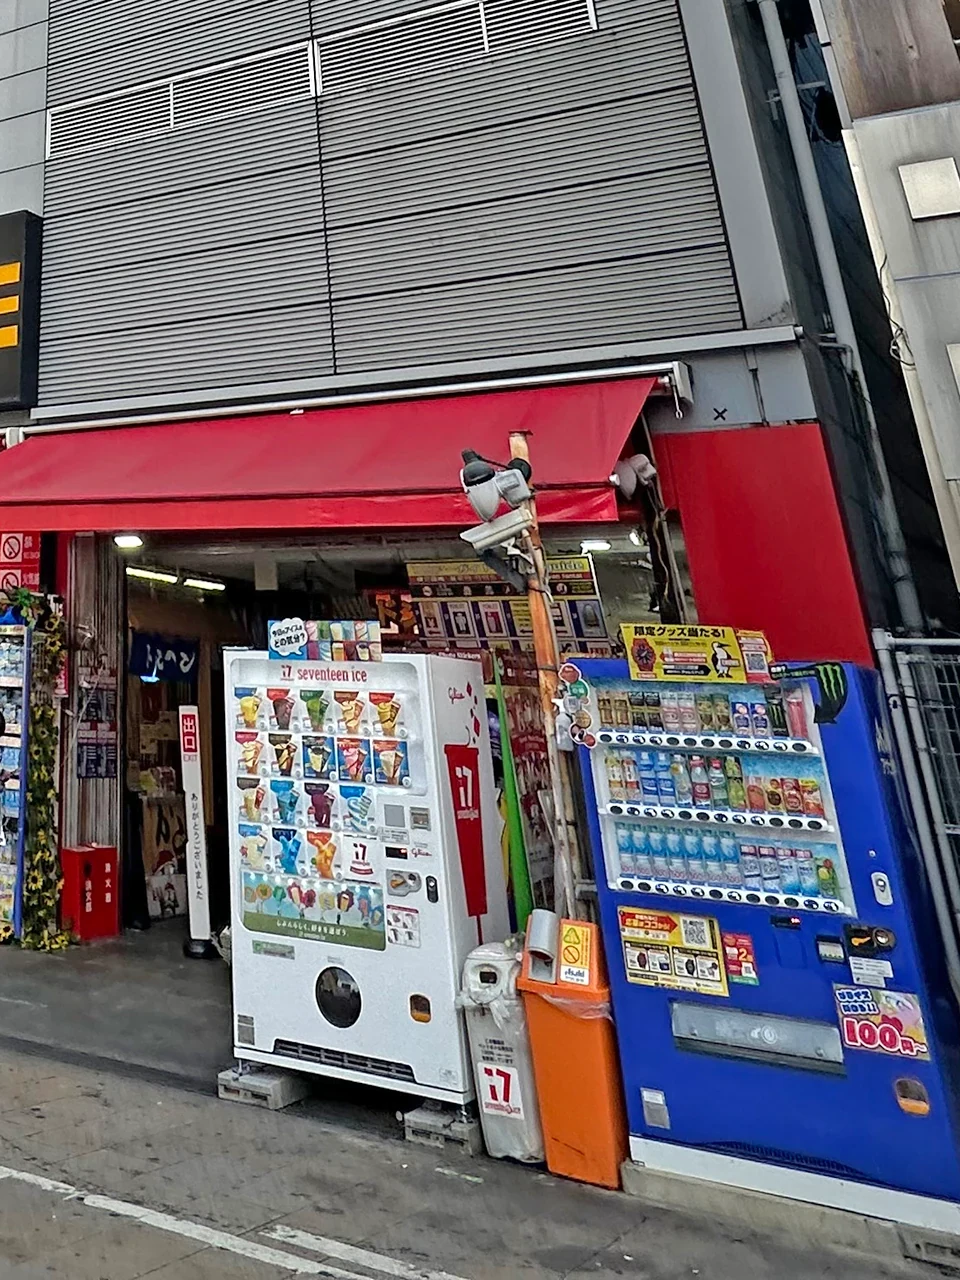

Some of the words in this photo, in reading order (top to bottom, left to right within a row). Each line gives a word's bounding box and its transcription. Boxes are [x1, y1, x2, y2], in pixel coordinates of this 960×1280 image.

[634, 626, 727, 639] 限定グッズ当たる!
[297, 667, 349, 682] seventeen
[351, 666, 368, 683] ice
[182, 715, 196, 750] 出口
[183, 754, 198, 762] EXIT
[190, 792, 203, 901] ありがとうございました
